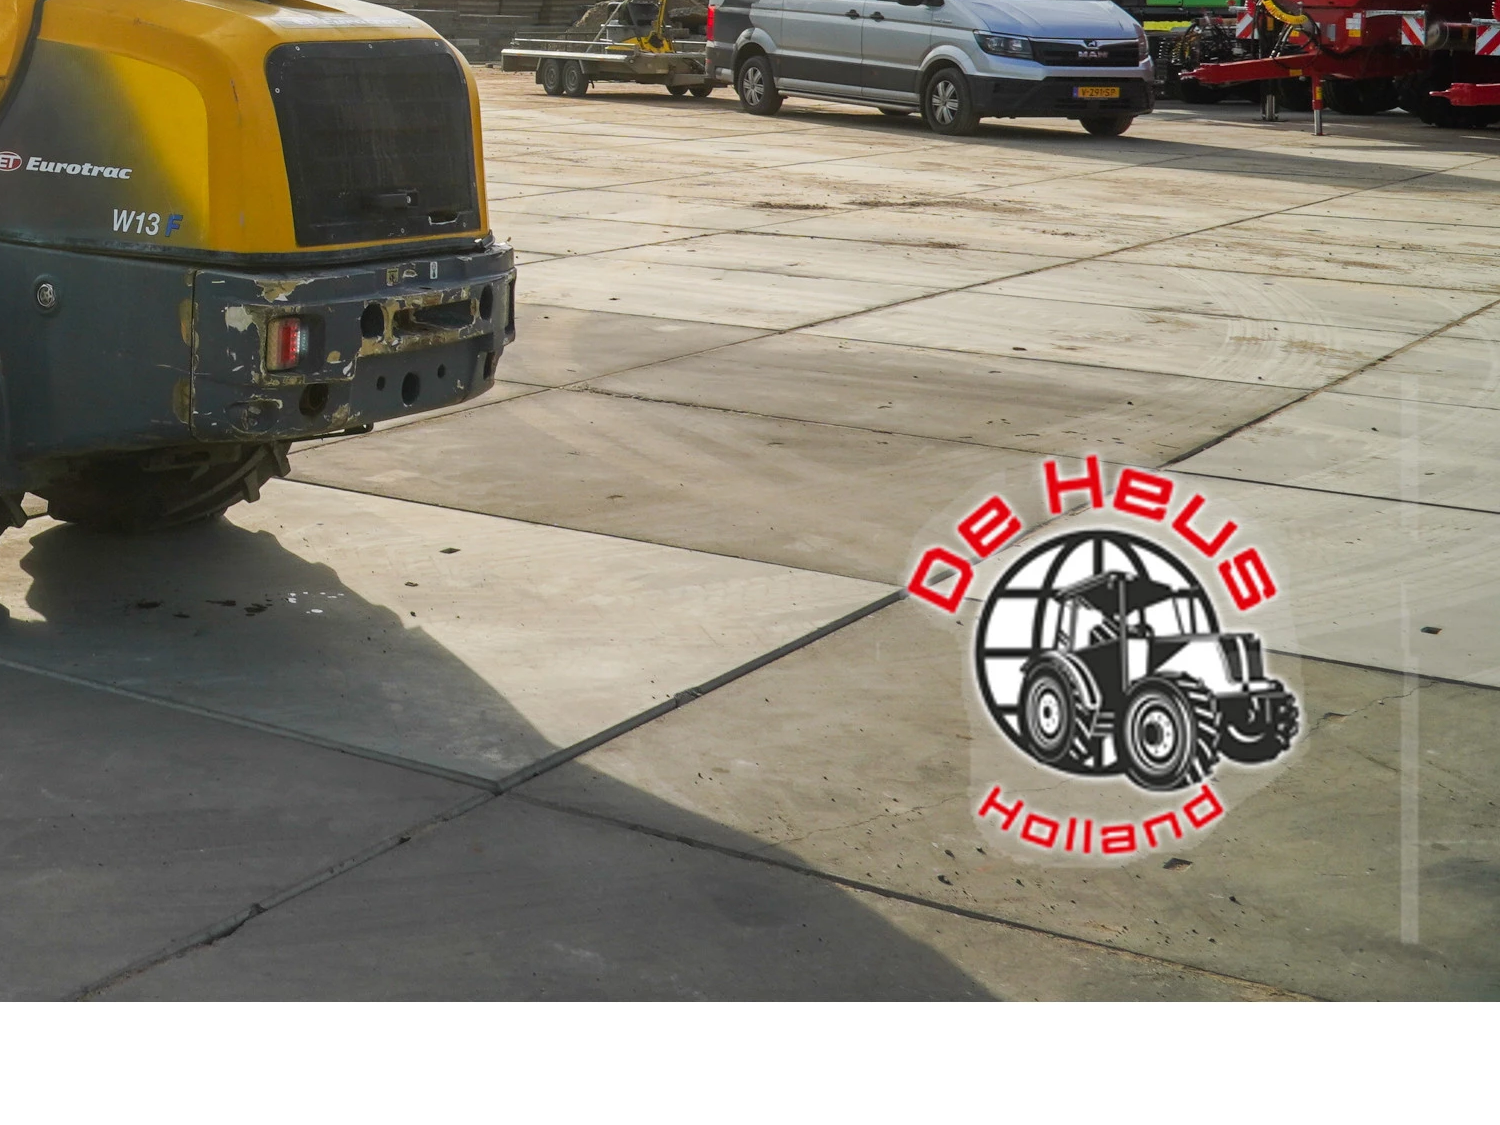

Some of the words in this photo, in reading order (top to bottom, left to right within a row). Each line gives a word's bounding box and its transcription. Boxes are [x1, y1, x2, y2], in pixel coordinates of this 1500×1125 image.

[1078, 50, 1109, 58] MAN
[26, 156, 133, 179] Eurotrac
[113, 208, 161, 236] W13
[164, 213, 184, 238] F
